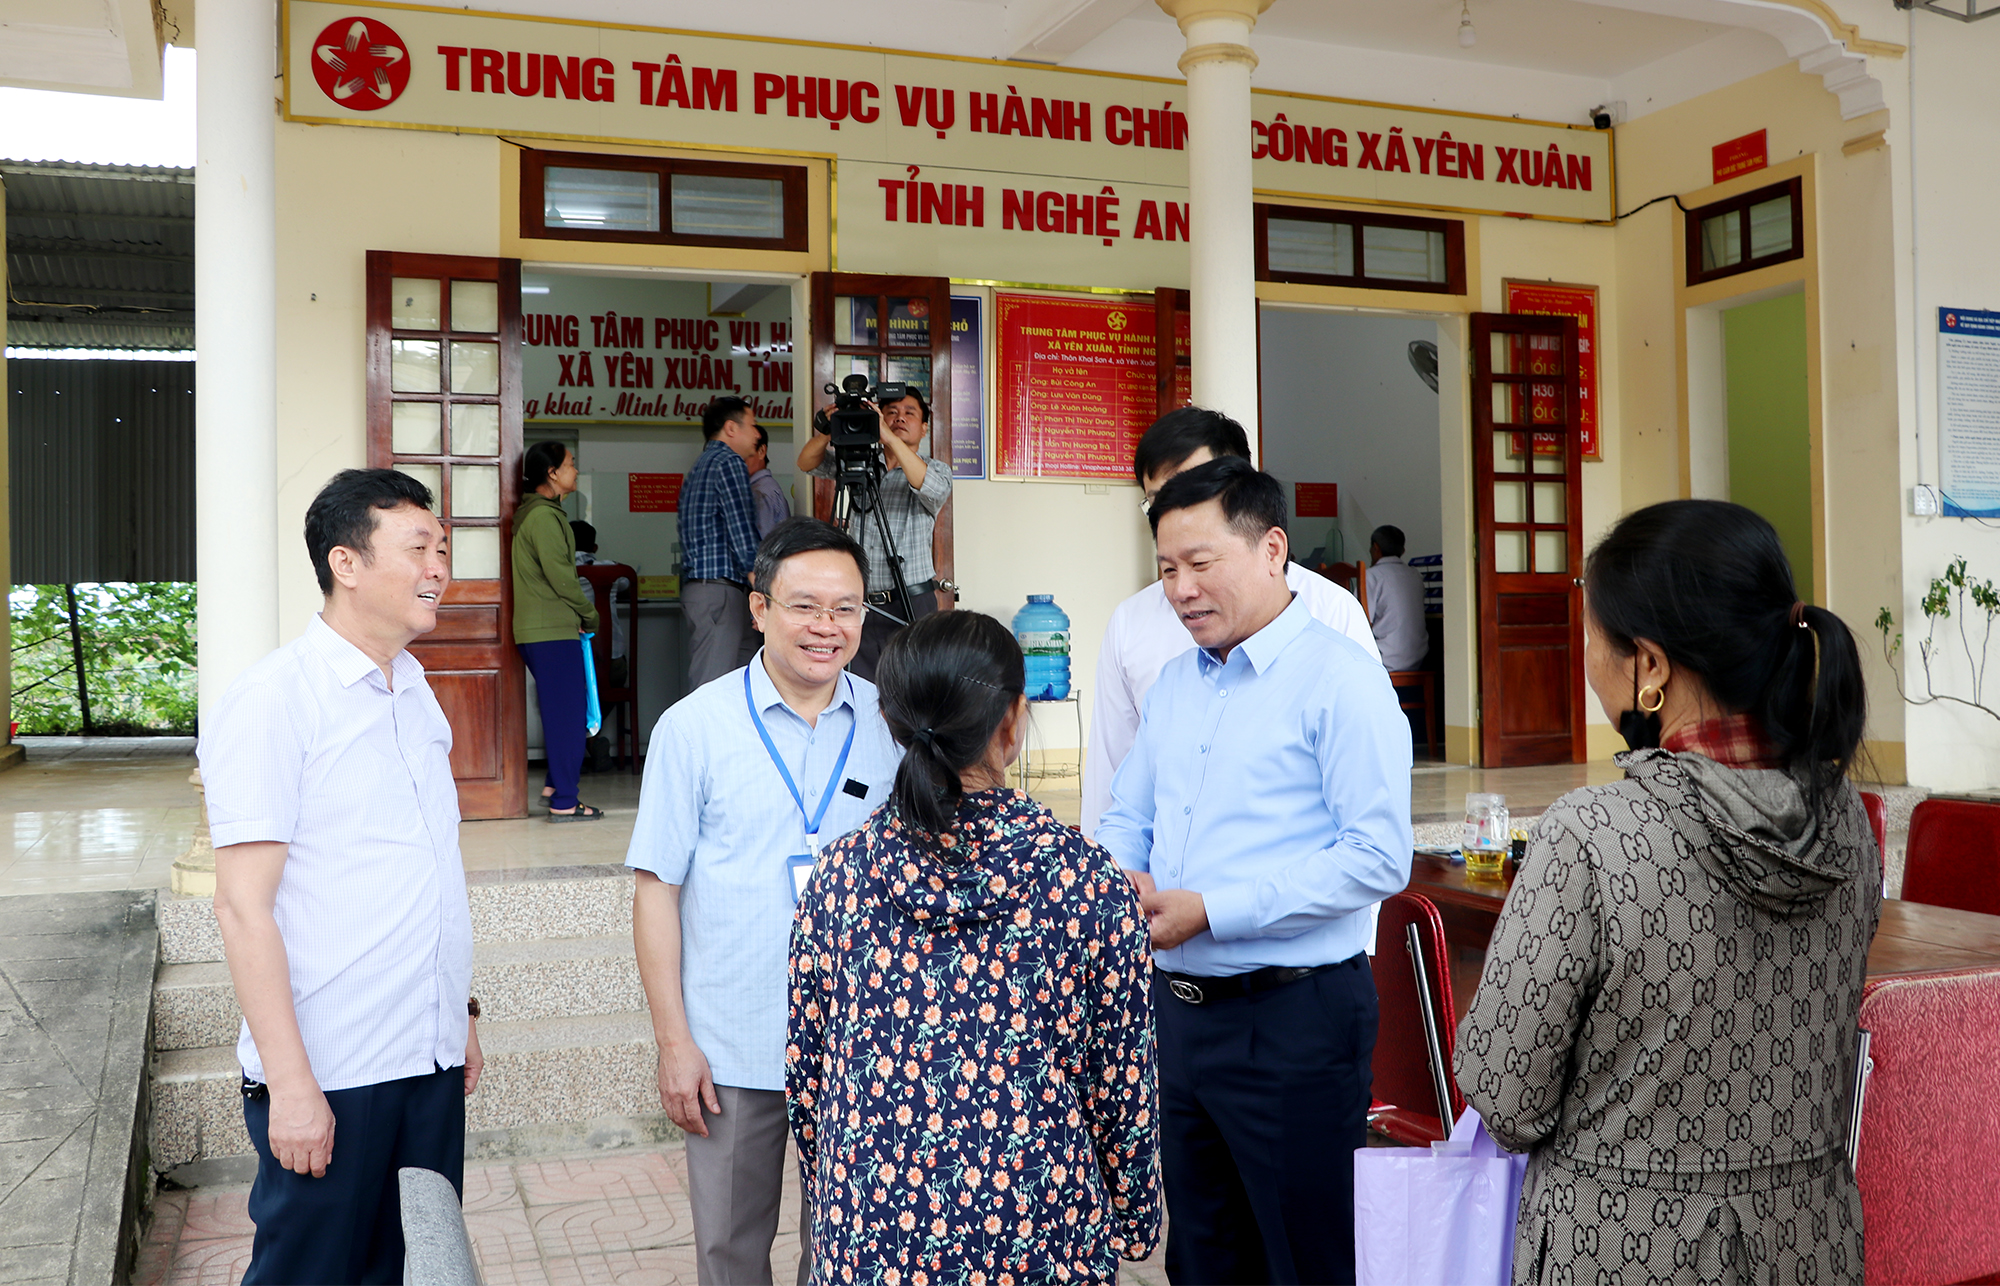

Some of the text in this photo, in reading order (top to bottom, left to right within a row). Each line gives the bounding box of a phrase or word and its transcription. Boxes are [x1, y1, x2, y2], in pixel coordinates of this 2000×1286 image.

[438, 46, 1591, 191] TRUNG TÂM PHỤC VỤ HÀNH CHÍN CÔNG XÃ YÊN XUÂN
[879, 165, 1189, 246] TỈNH NGHỆ AN
[889, 317, 919, 329] HÌNH
[521, 314, 579, 347] UNG
[590, 311, 644, 348] TÂM
[655, 318, 719, 355] PHỤC
[729, 321, 760, 357] VỤ
[1020, 326, 1053, 337] TRUNG
[1056, 327, 1077, 338] TÂM
[1080, 330, 1106, 341] PHỤC
[1109, 332, 1121, 343] VỤ
[1124, 333, 1150, 344] HÀNH
[1048, 340, 1156, 356] XÃ YÊN XUÂN, TỈNH NG
[1034, 352, 1046, 360] Địa
[1047, 352, 1060, 360] chỉ:
[1061, 354, 1077, 362] Thôn
[1079, 355, 1093, 363] Khai
[1126, 358, 1138, 366] Yên
[558, 350, 793, 394] XÃ YÊN XUÂN, TỈN
[1052, 366, 1088, 376] Họ và tên
[1126, 371, 1145, 379] Chức
[1030, 377, 1049, 386] Ông:
[1064, 380, 1084, 388] Công
[1016, 389, 1021, 397] 2
[1030, 389, 1049, 398] Ông:
[1082, 393, 1102, 401] Dũng
[544, 392, 593, 416] khai
[610, 391, 668, 417] Minh
[1030, 401, 1049, 410] Ông:
[1082, 405, 1107, 414] Hoàng
[1123, 407, 1147, 415] Chuyên
[1065, 416, 1075, 424] Thị
[1095, 418, 1115, 426] Dung
[1123, 419, 1147, 427] Chuyên
[1045, 426, 1074, 435] Nguyễn
[1076, 428, 1086, 436] Thị
[1088, 429, 1115, 438] Phương
[1062, 441, 1072, 449] Thị
[1073, 442, 1098, 450] Hương
[1045, 450, 1074, 460] Nguyễn
